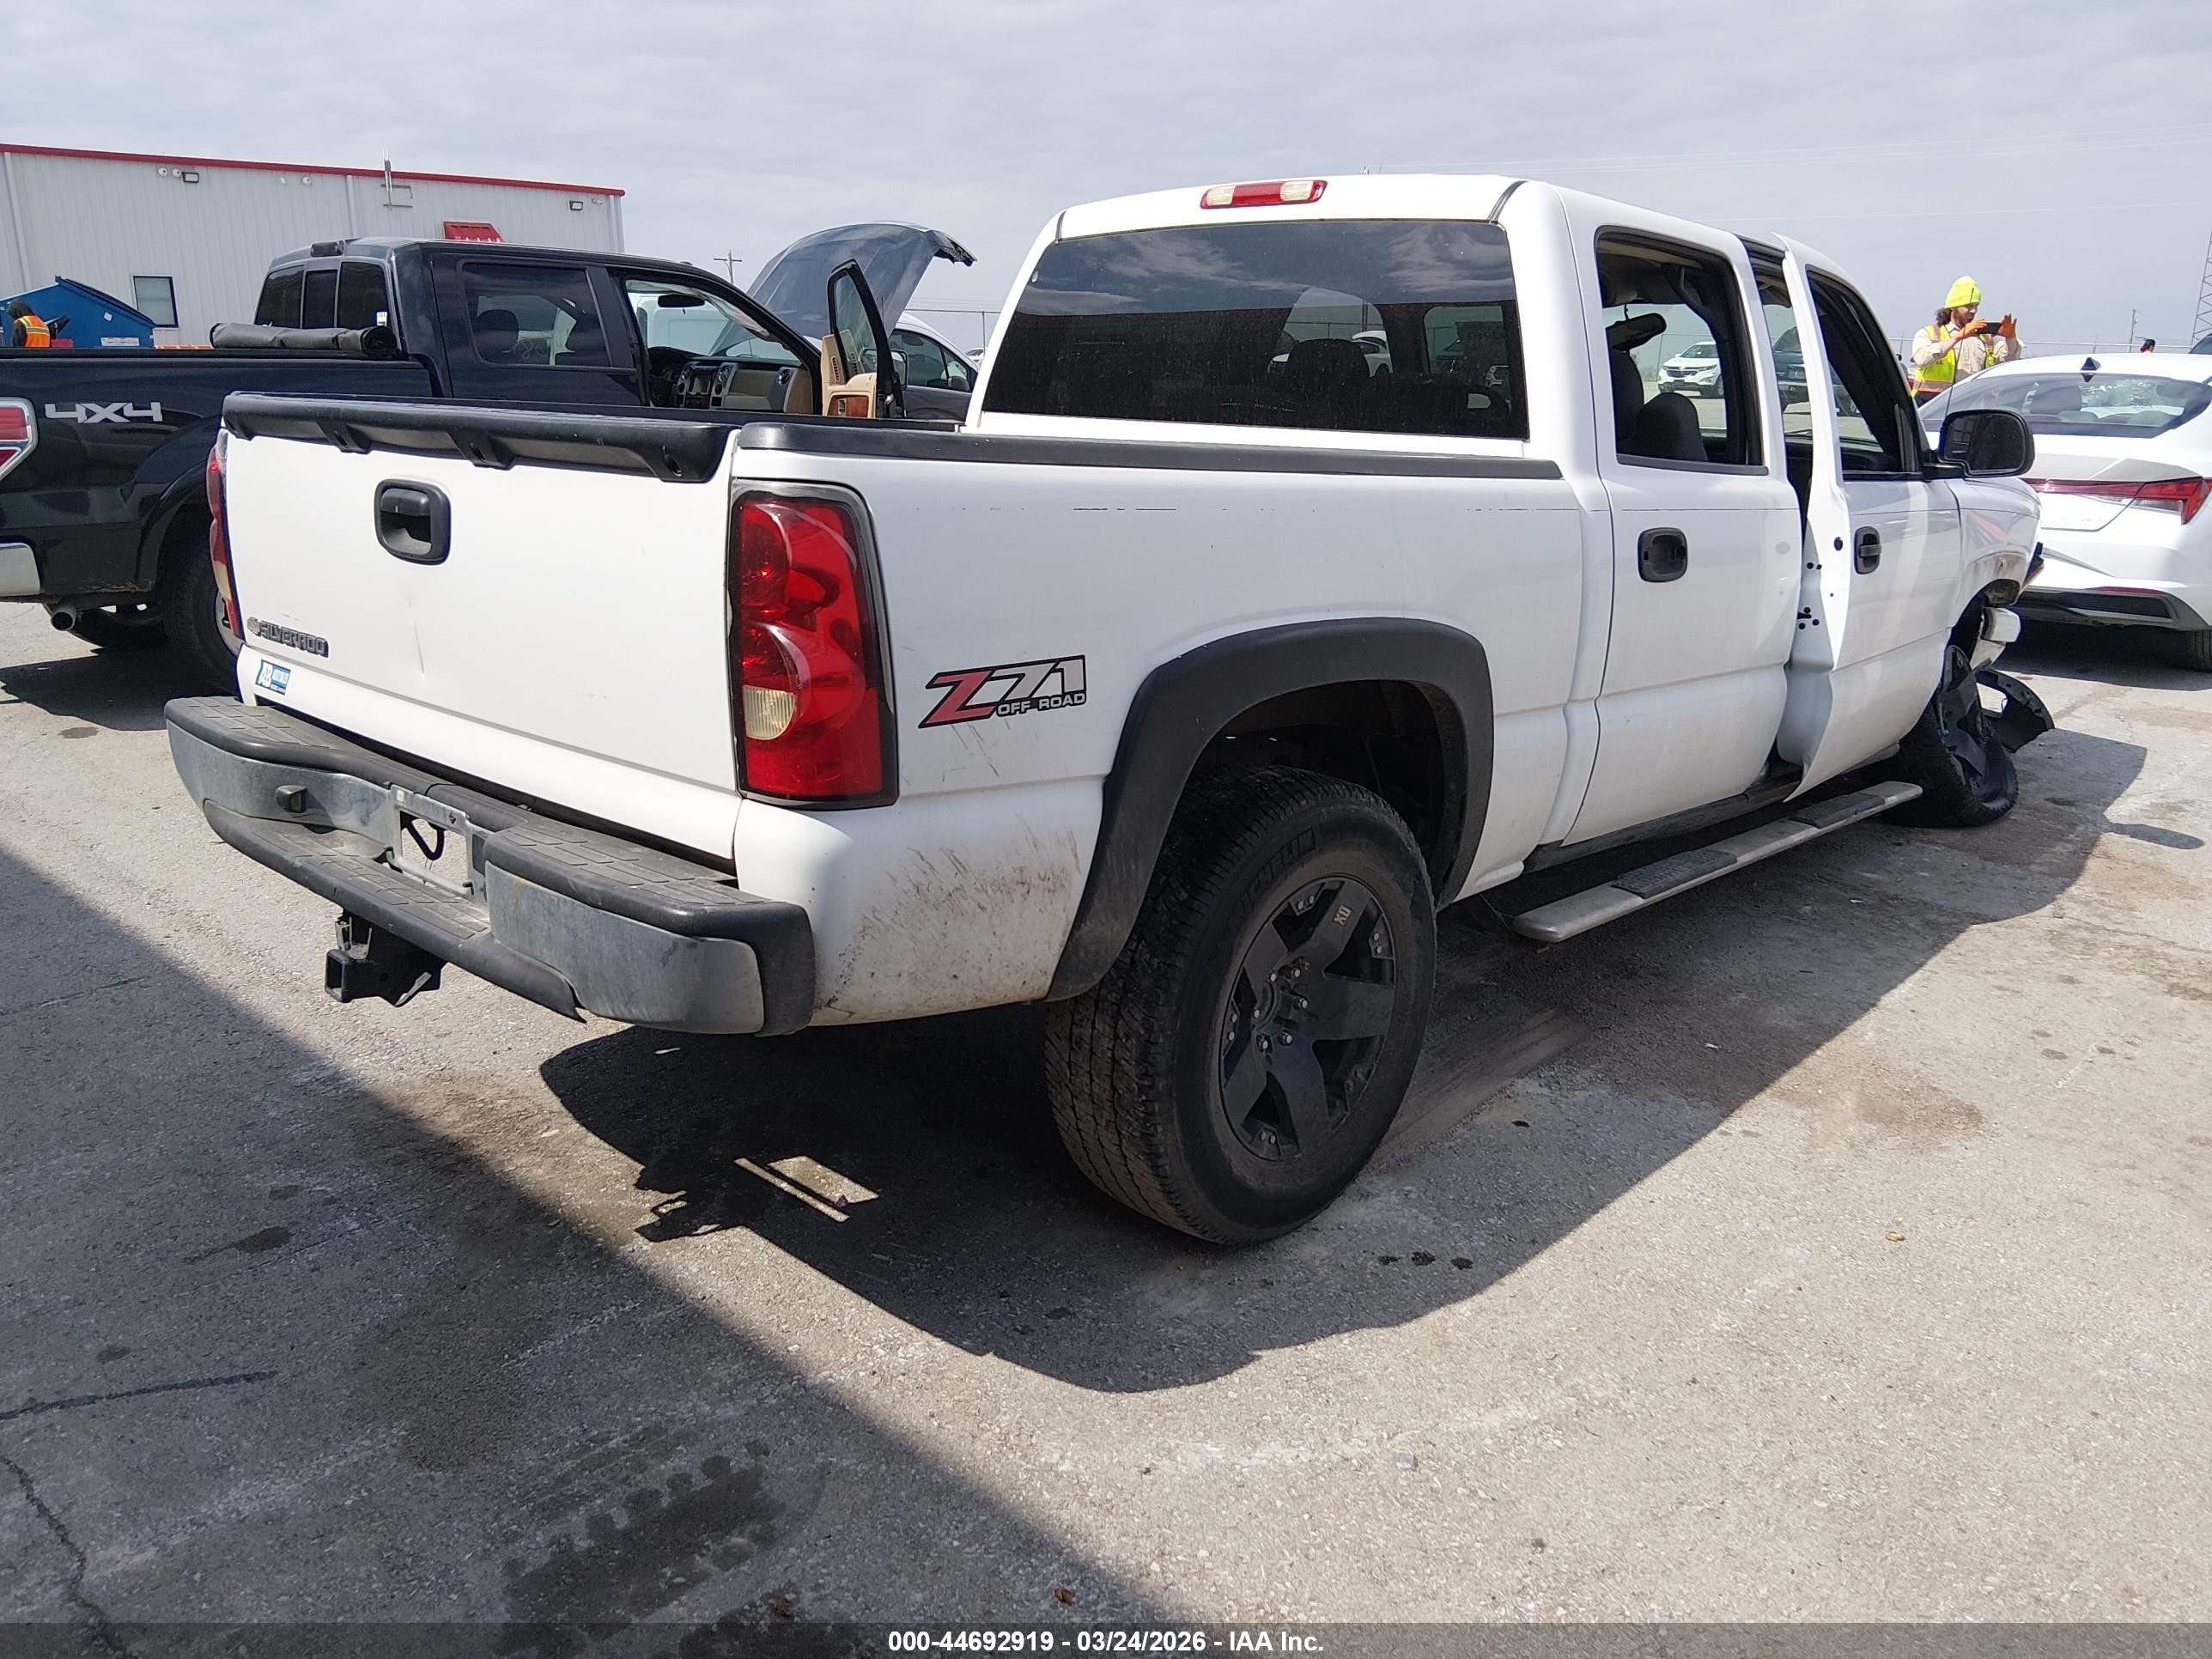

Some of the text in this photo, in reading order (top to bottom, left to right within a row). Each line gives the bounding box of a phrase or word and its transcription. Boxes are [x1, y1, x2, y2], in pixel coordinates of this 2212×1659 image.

[259, 620, 329, 658] SILVERADO
[918, 655, 1086, 729] Z71
[997, 692, 1086, 717] OFF ROAD
